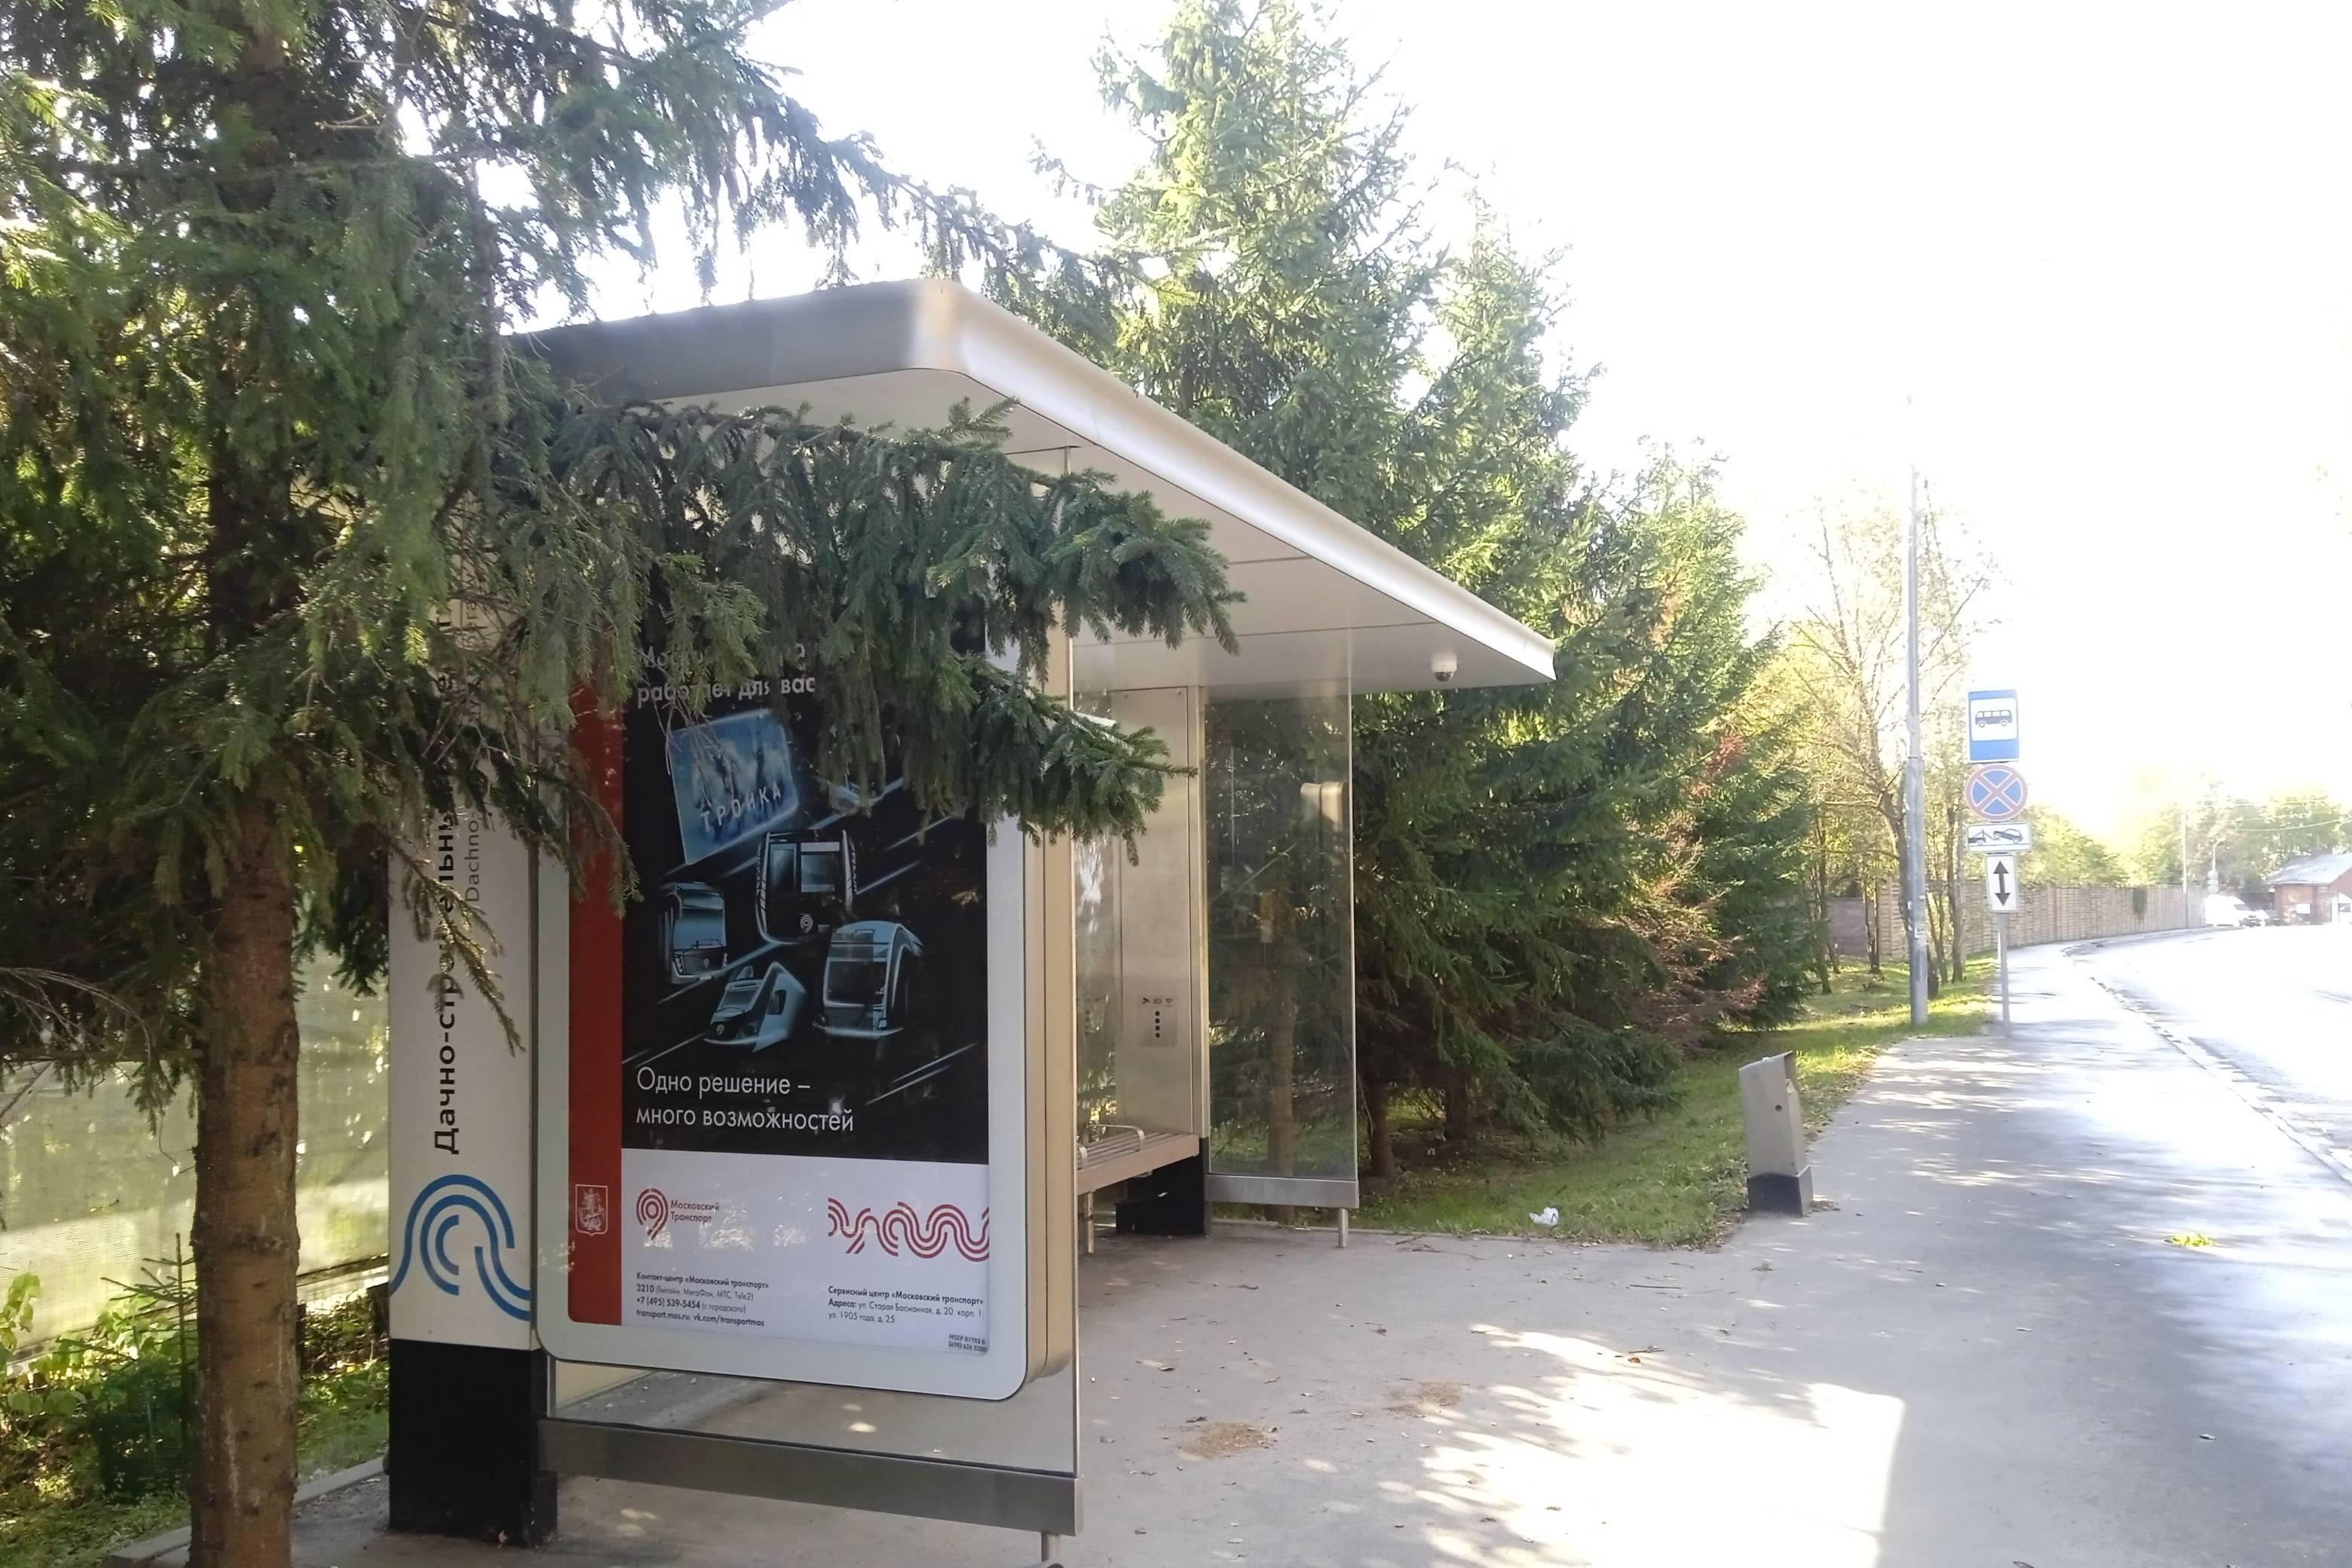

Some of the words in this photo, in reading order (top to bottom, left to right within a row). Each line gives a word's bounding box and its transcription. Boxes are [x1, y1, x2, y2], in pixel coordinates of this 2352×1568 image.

[780, 677, 816, 694] вас
[637, 1067, 692, 1094] Одно
[699, 1075, 791, 1099] решение
[636, 1108, 696, 1125] много
[703, 1109, 853, 1132] возможностей
[670, 1199, 720, 1211] Московский
[670, 1211, 712, 1224] Транспорт
[636, 1272, 684, 1285] Контакт-центр
[685, 1276, 730, 1286] «Московский
[730, 1280, 769, 1291] транспорт»
[636, 1283, 655, 1293] 3210
[636, 1296, 645, 1304] +7
[646, 1297, 665, 1307] (495)
[666, 1298, 700, 1309] 539-5454
[828, 1285, 868, 1297] Сервисный
[868, 1291, 890, 1300] центр
[891, 1291, 940, 1303] «Московский
[942, 1296, 984, 1307] транспорт»
[828, 1297, 857, 1309] Адреса:
[869, 1300, 893, 1311] Старая
[694, 1312, 765, 1327] vk.com/transportmos
[841, 1311, 858, 1321] 1905
[885, 1314, 896, 1323] 25
